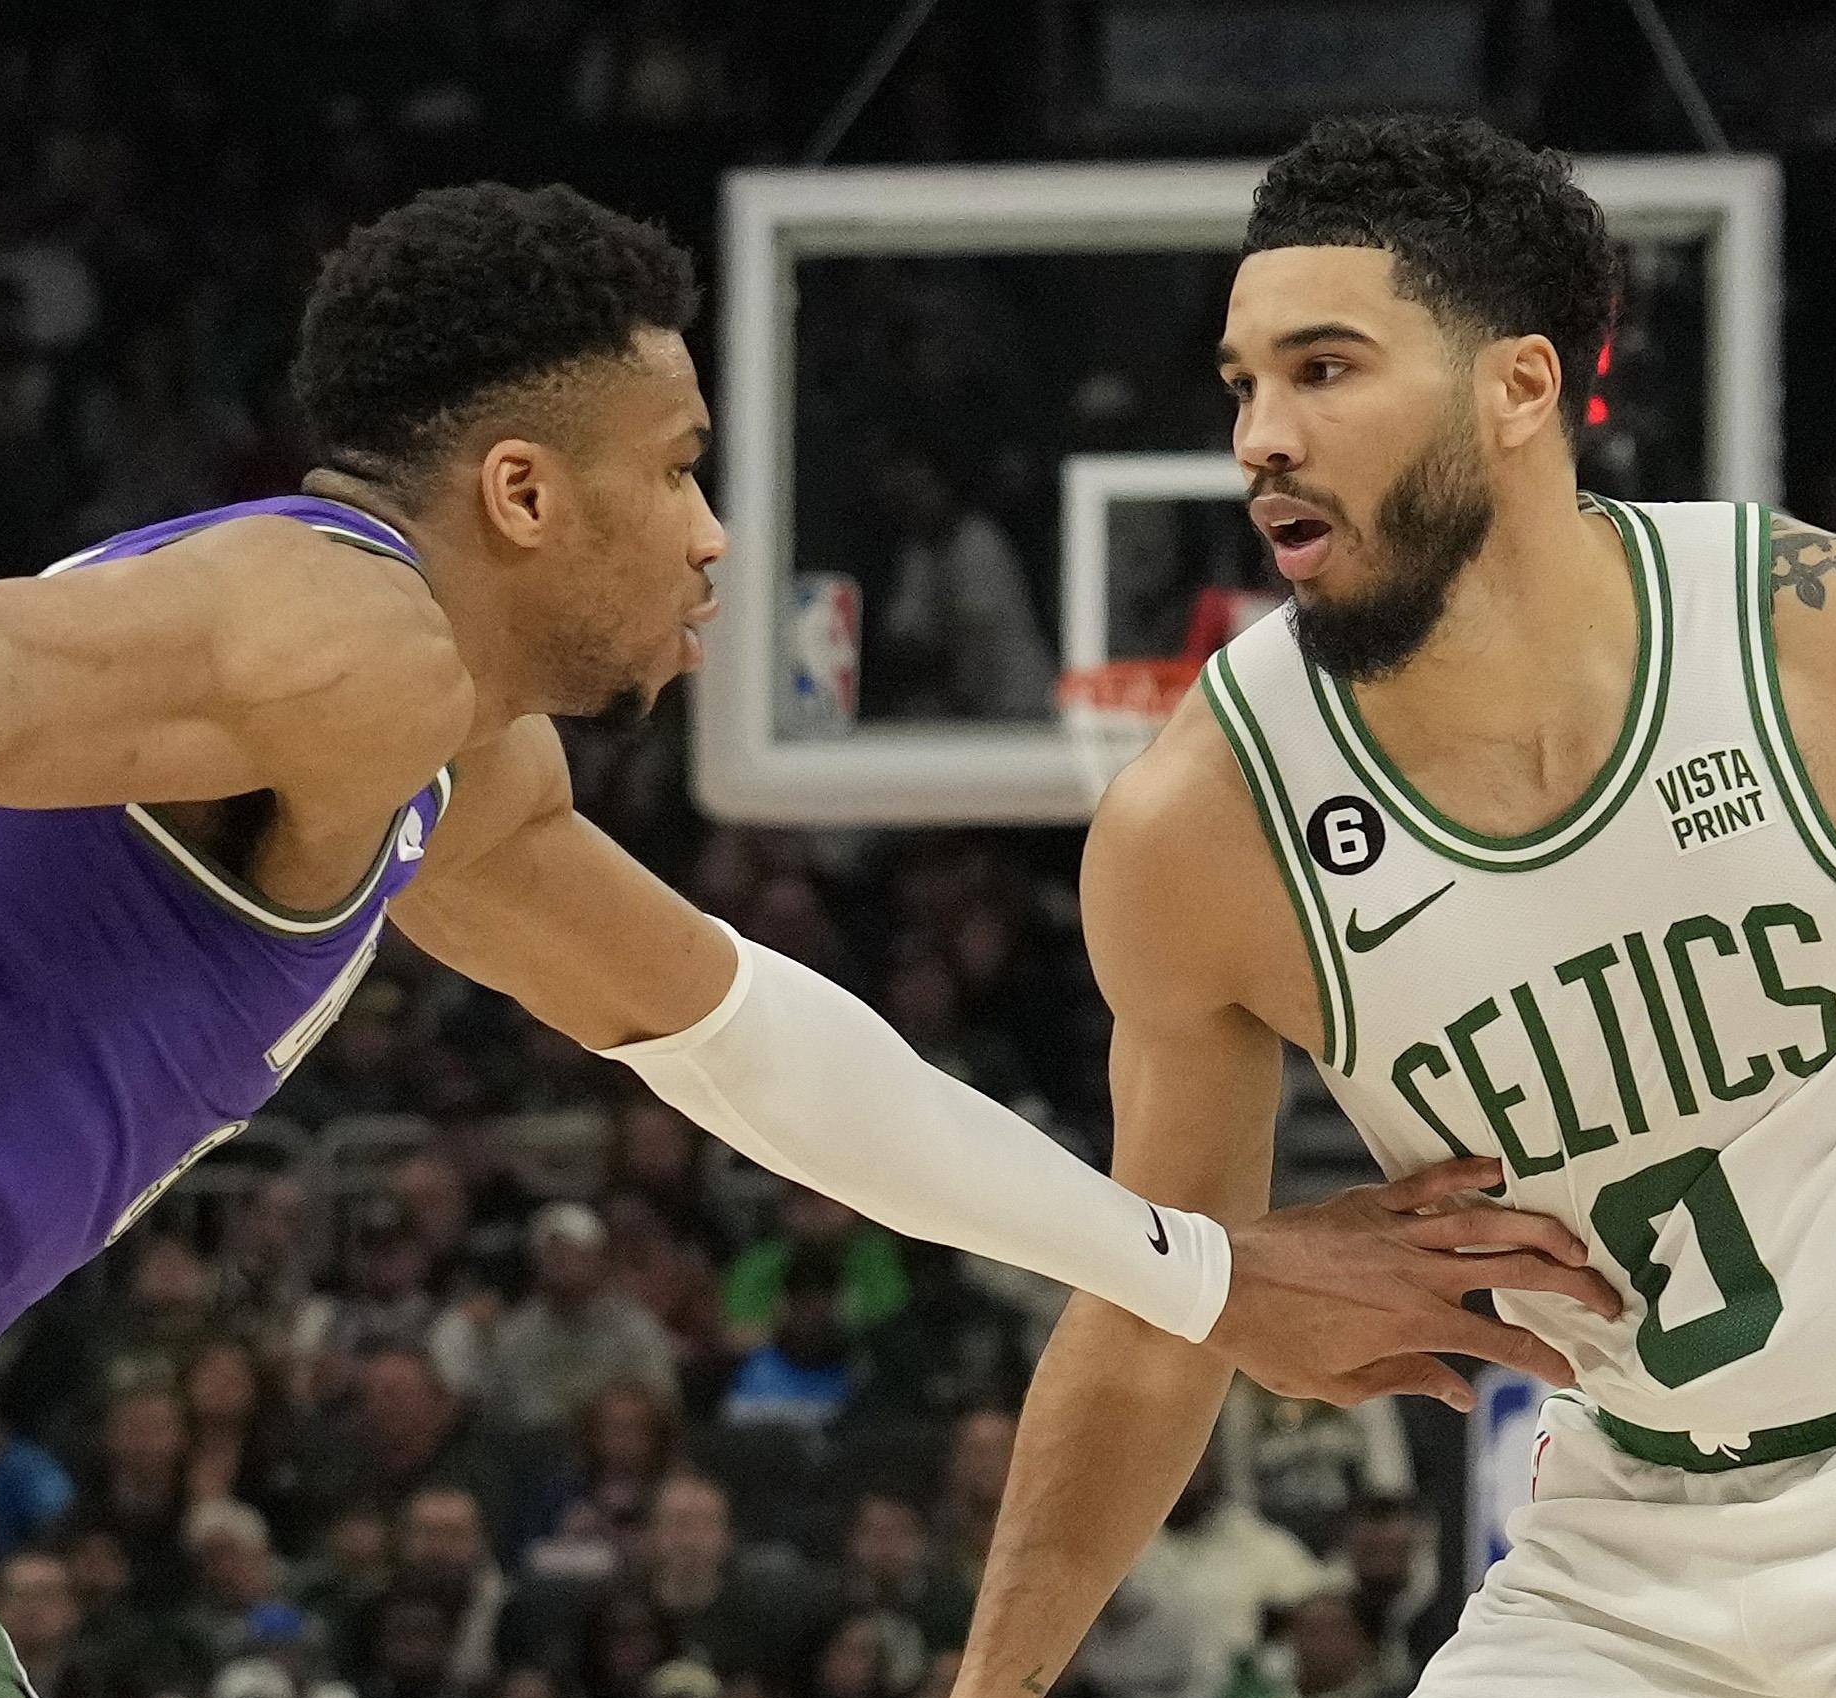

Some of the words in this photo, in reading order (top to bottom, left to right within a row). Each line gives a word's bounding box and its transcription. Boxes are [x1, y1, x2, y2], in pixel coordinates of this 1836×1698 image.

[1655, 748, 1759, 817] VISTA
[1325, 811, 1369, 867] 6
[1672, 791, 1770, 851] PRINT
[1590, 1146, 1785, 1390] 0
